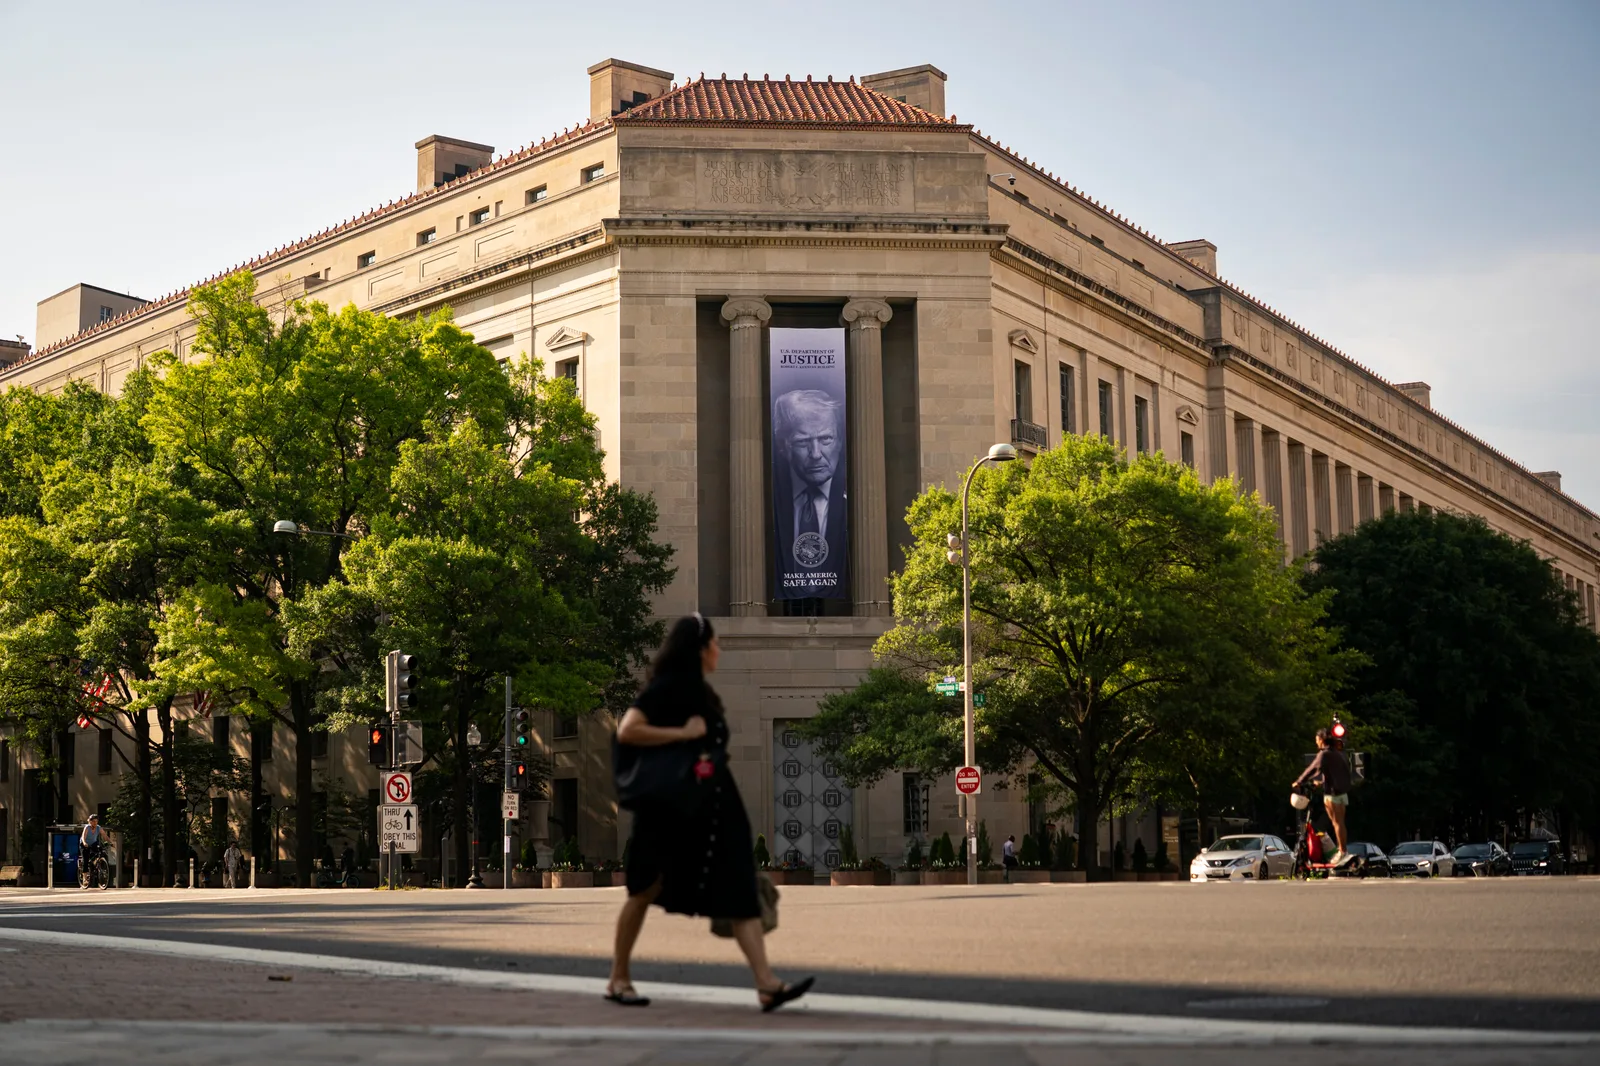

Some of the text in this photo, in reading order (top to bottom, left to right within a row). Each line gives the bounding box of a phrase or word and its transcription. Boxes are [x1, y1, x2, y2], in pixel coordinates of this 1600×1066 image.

[705, 161, 754, 170] JUSTICE
[759, 161, 772, 170] IN
[837, 163, 855, 172] THE
[886, 163, 905, 173] AND
[704, 169, 755, 179] CONDUCT
[862, 172, 891, 182] STATE
[712, 178, 772, 188] POSSIBLE
[723, 187, 761, 196] RESIDES
[765, 187, 774, 196] IN
[862, 189, 900, 198] HEARTS
[709, 195, 729, 204] AND
[732, 195, 762, 205] SOULS
[856, 197, 900, 207] CITIZENS
[780, 354, 835, 364] JUSTICE
